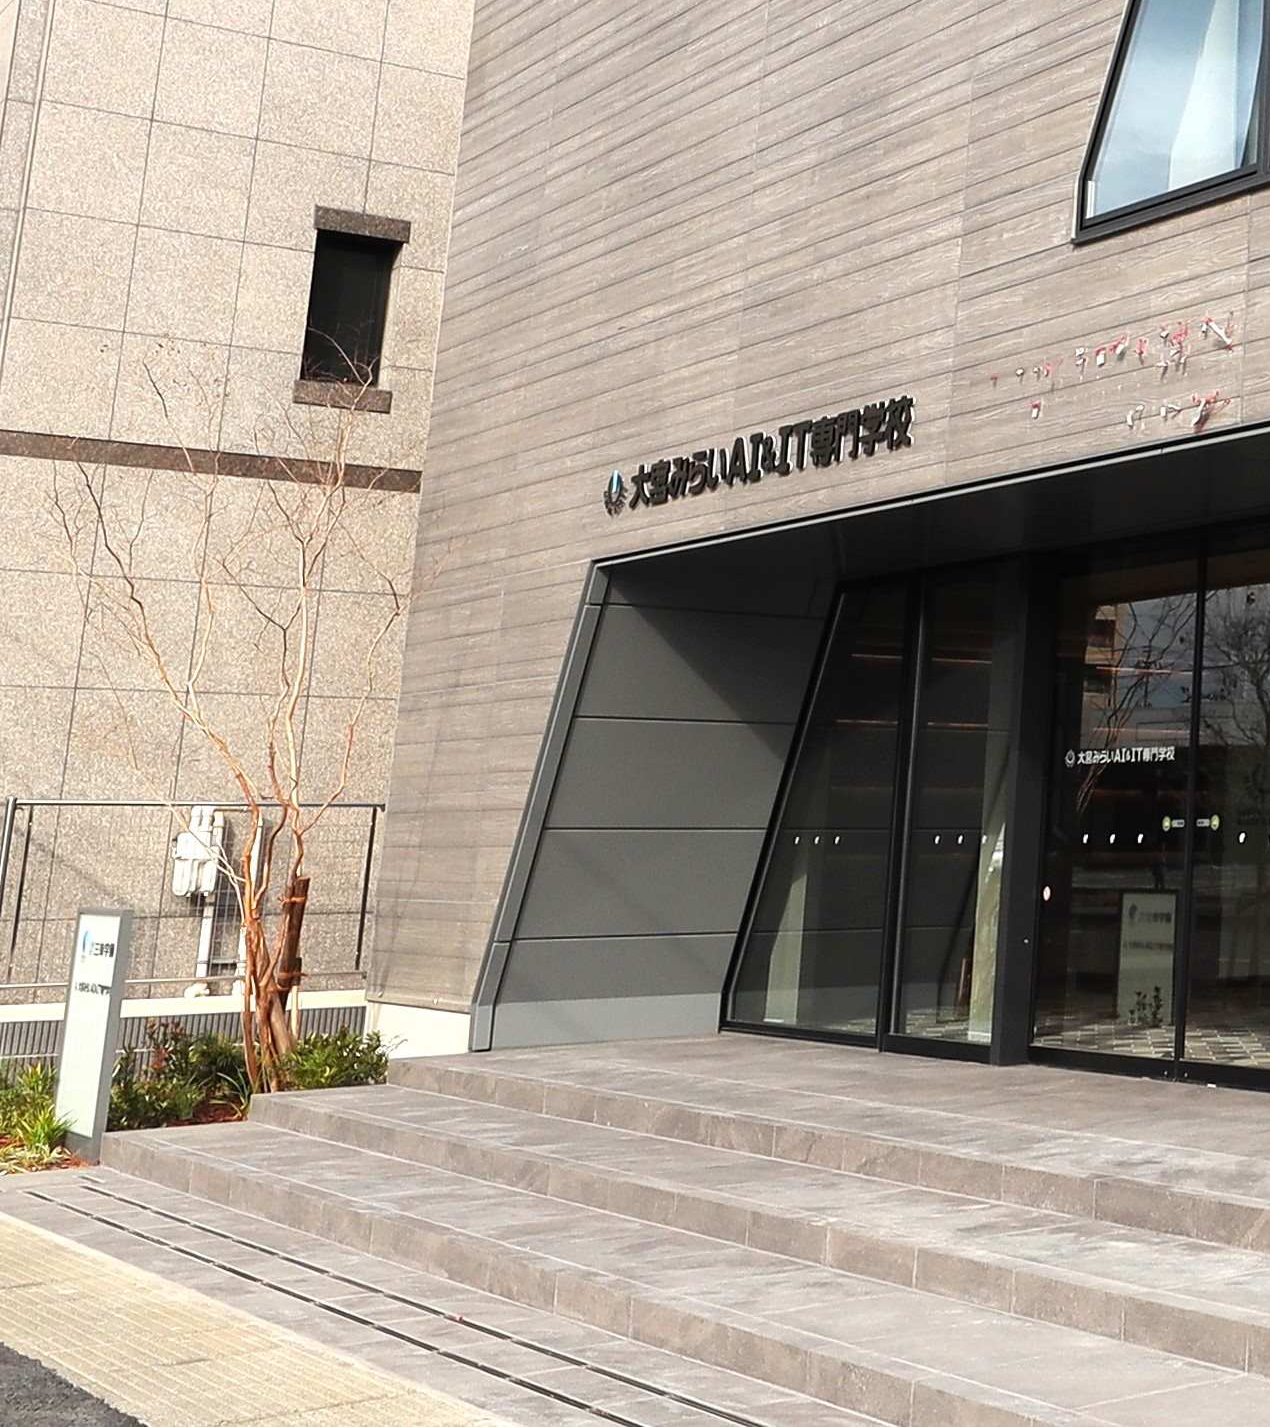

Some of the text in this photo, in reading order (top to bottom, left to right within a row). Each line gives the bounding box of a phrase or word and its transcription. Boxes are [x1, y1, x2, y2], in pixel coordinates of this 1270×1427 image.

[628, 395, 917, 510] 大宮みらいAI&IT専門学校
